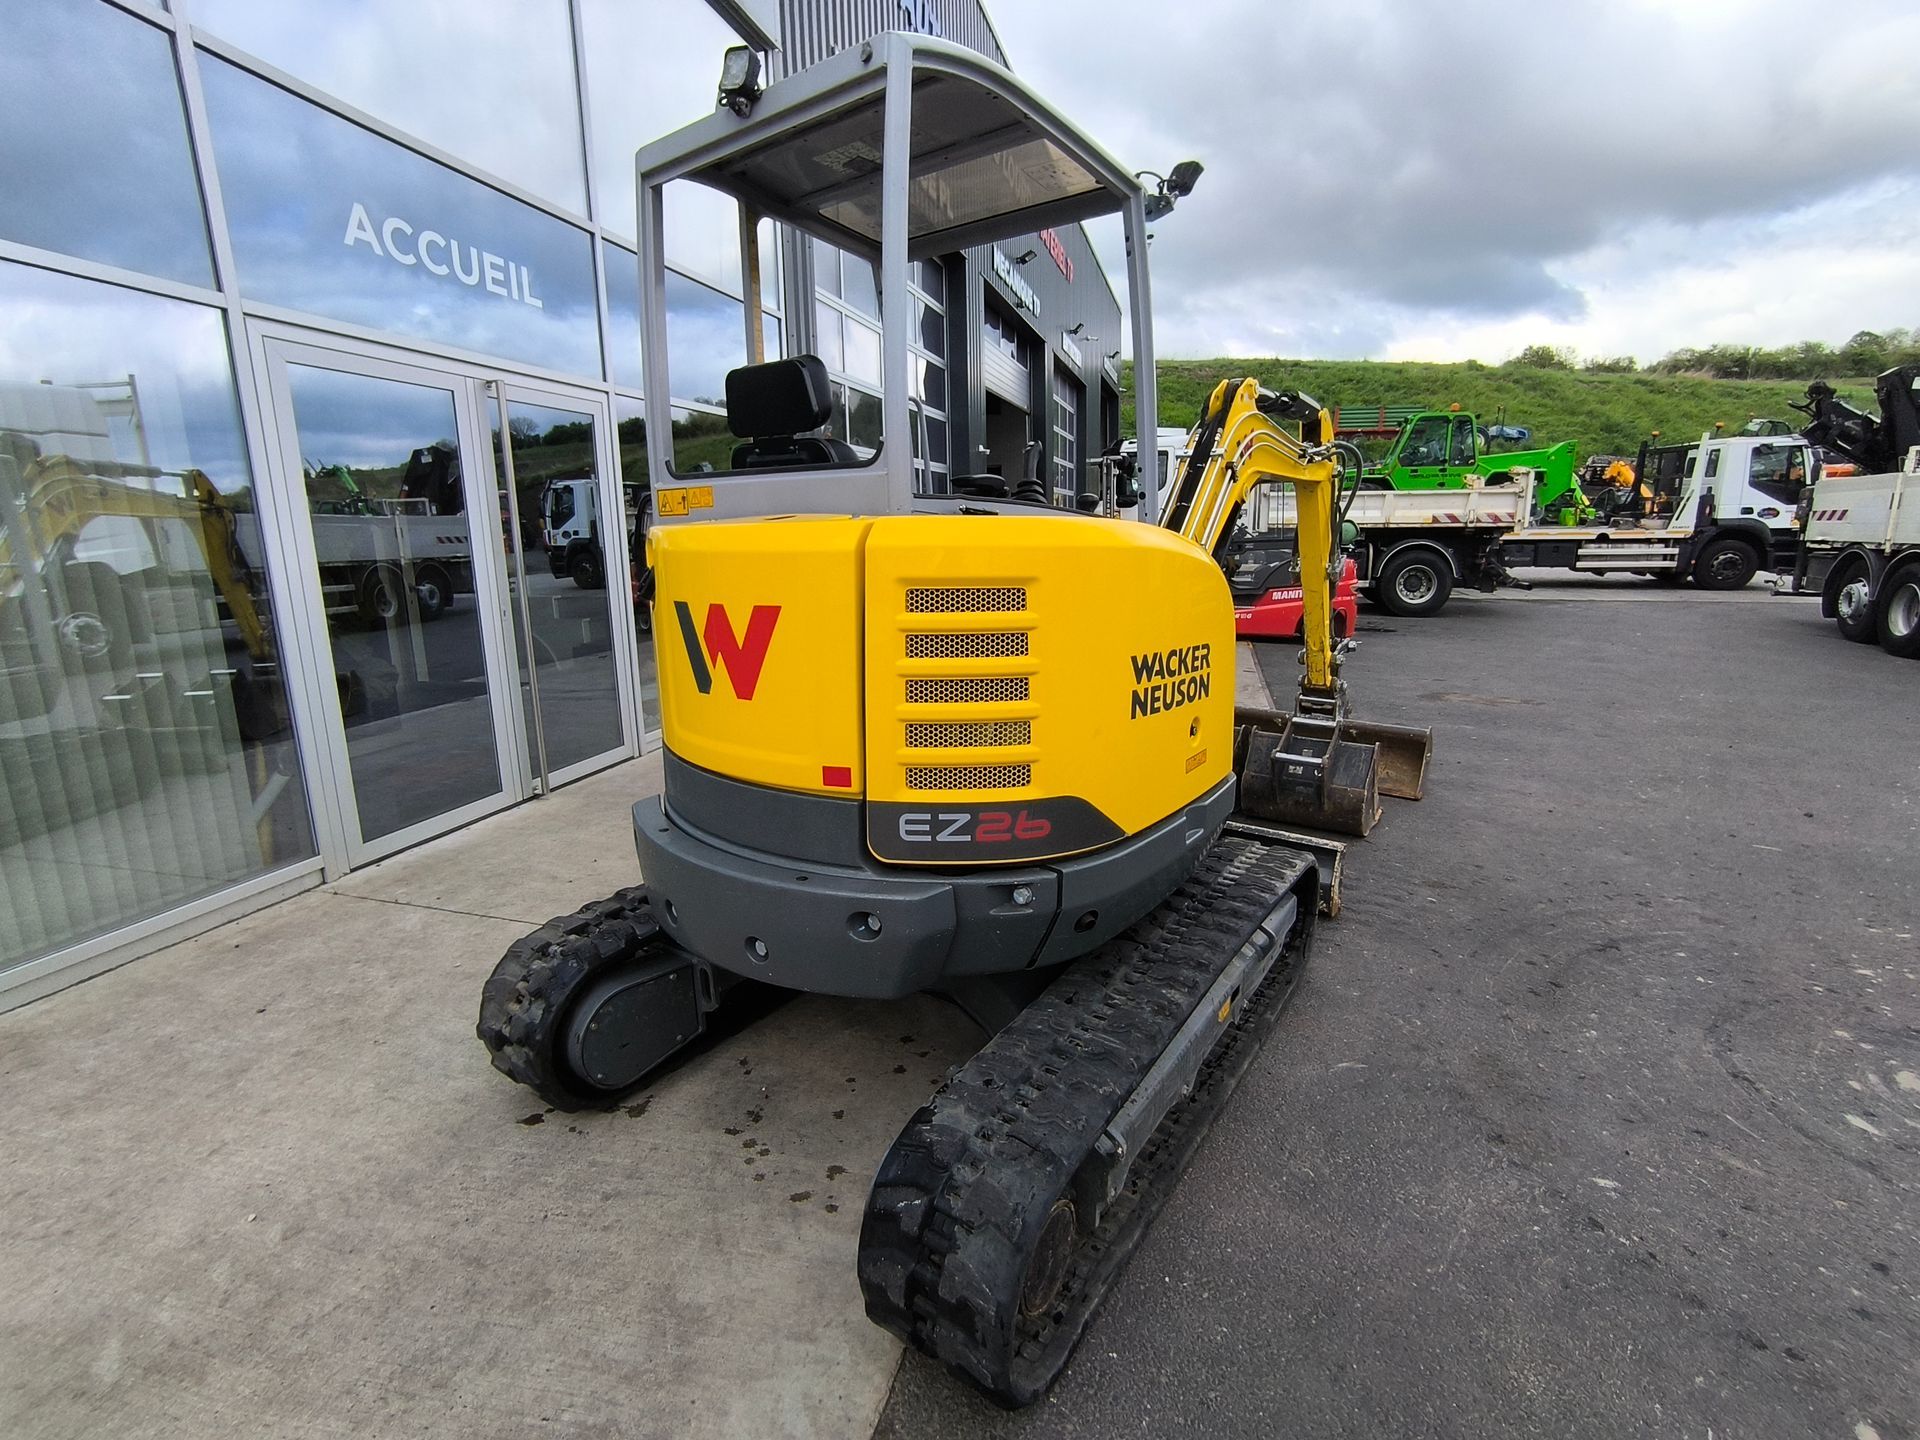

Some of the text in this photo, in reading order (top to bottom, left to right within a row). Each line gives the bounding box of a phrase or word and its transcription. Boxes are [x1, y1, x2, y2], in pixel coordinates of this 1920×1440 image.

[343, 202, 543, 308] ACCUEIL
[1130, 643, 1211, 685] WACKER
[1130, 672, 1211, 720] NEUSON
[899, 810, 1052, 842] EZ26
